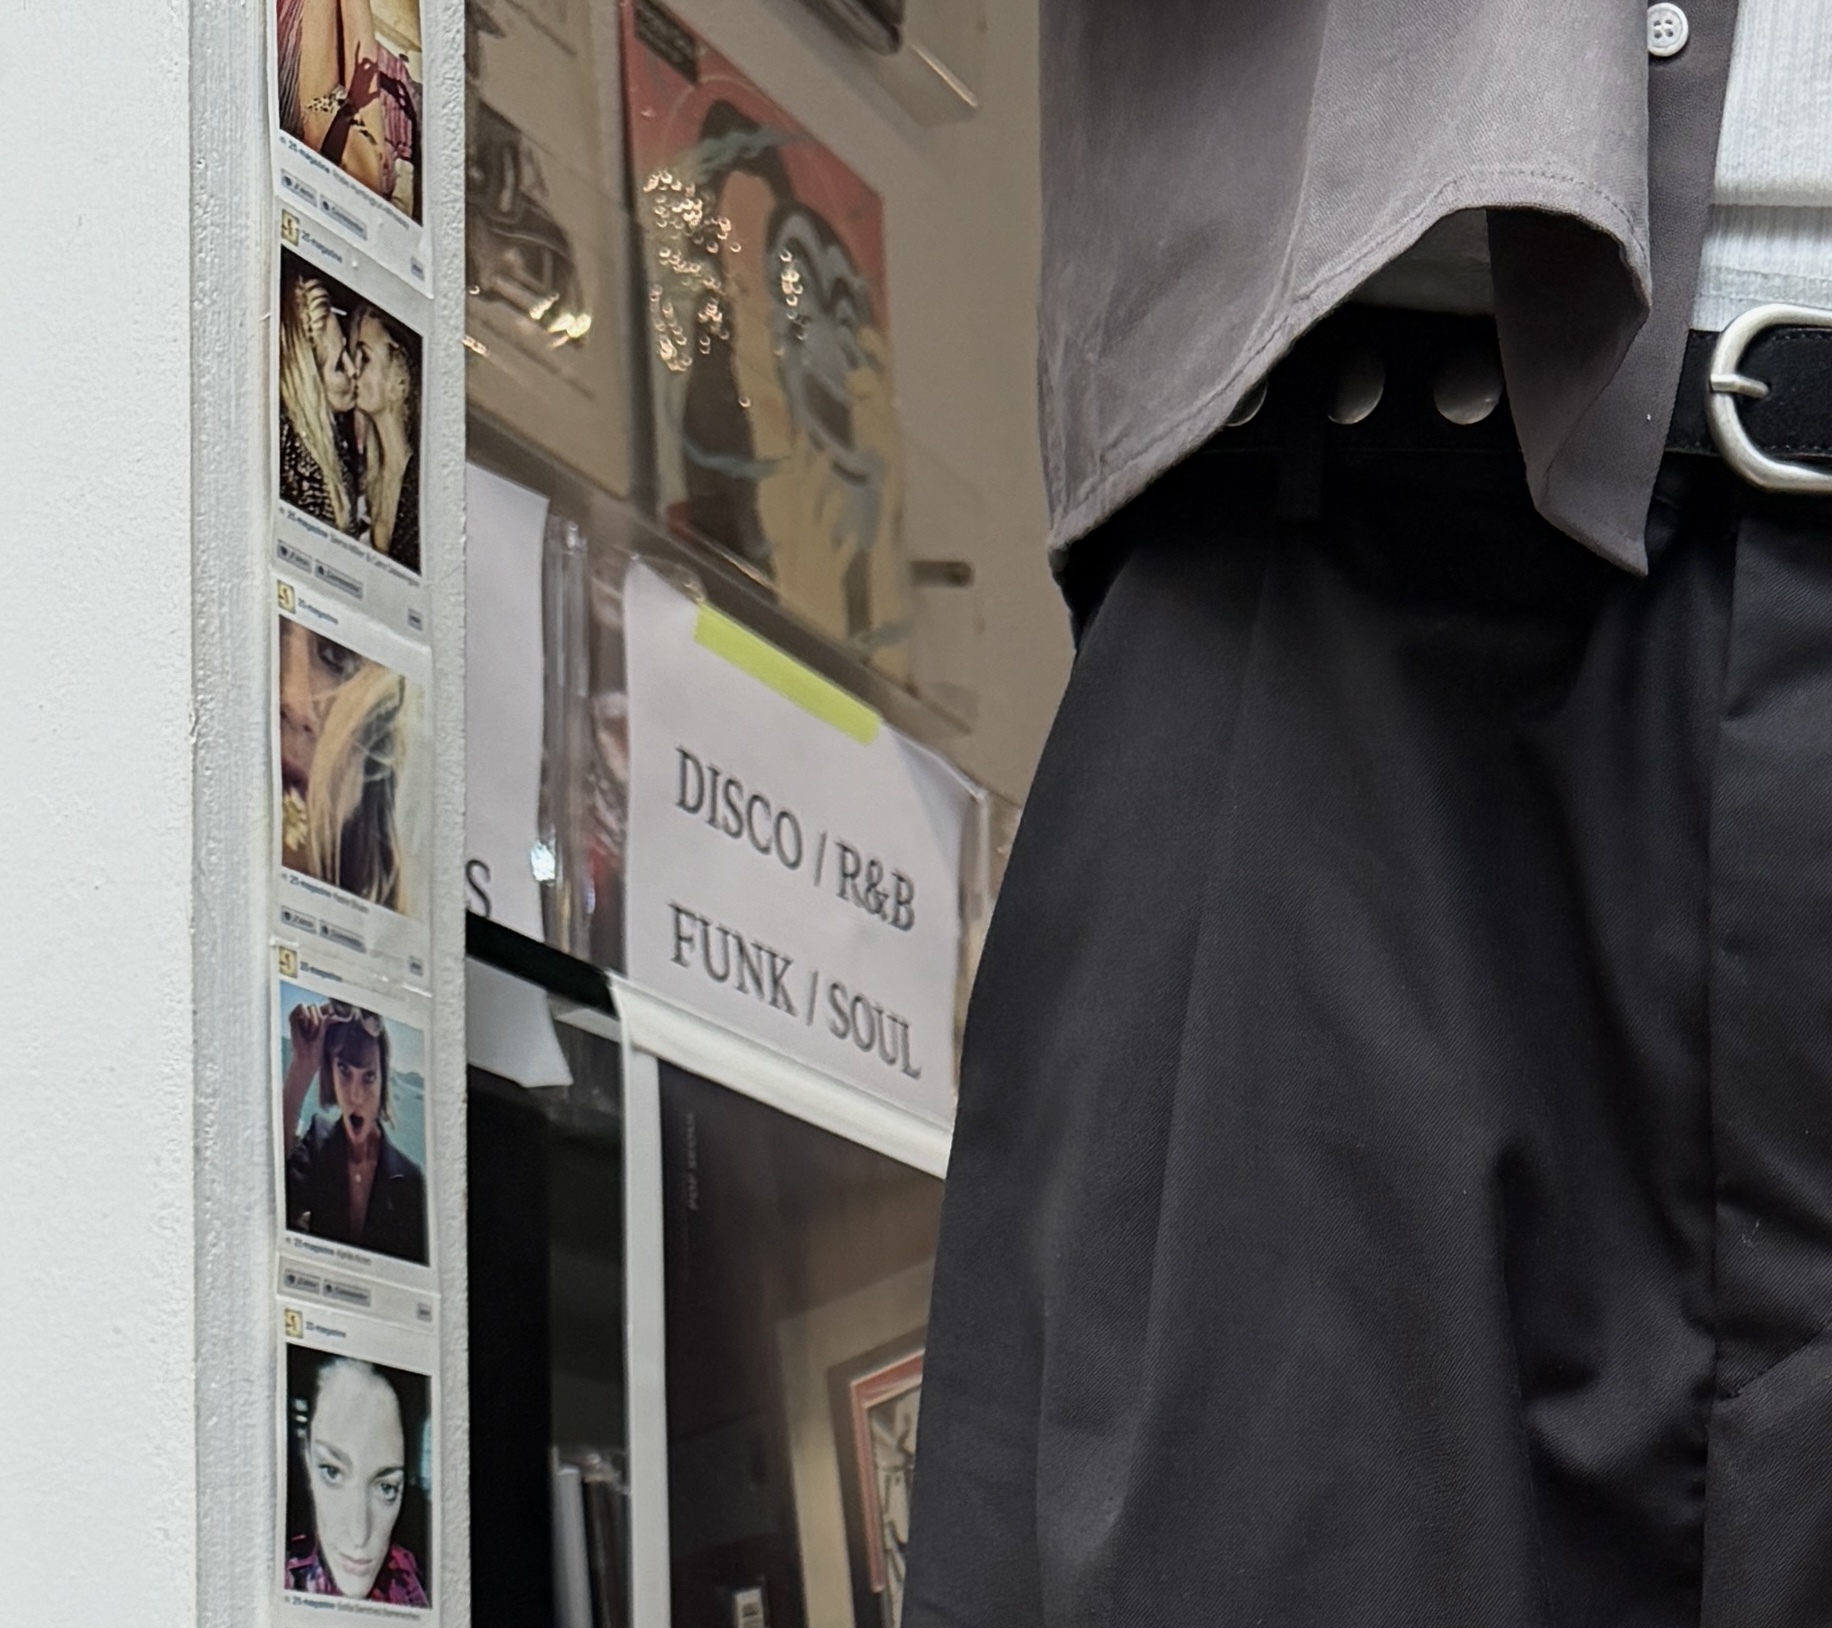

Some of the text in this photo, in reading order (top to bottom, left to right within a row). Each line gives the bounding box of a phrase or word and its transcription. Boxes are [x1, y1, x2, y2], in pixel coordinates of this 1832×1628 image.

[675, 746, 917, 932] DISCO / R&B
[669, 903, 922, 1080] FUNK / SOUL
